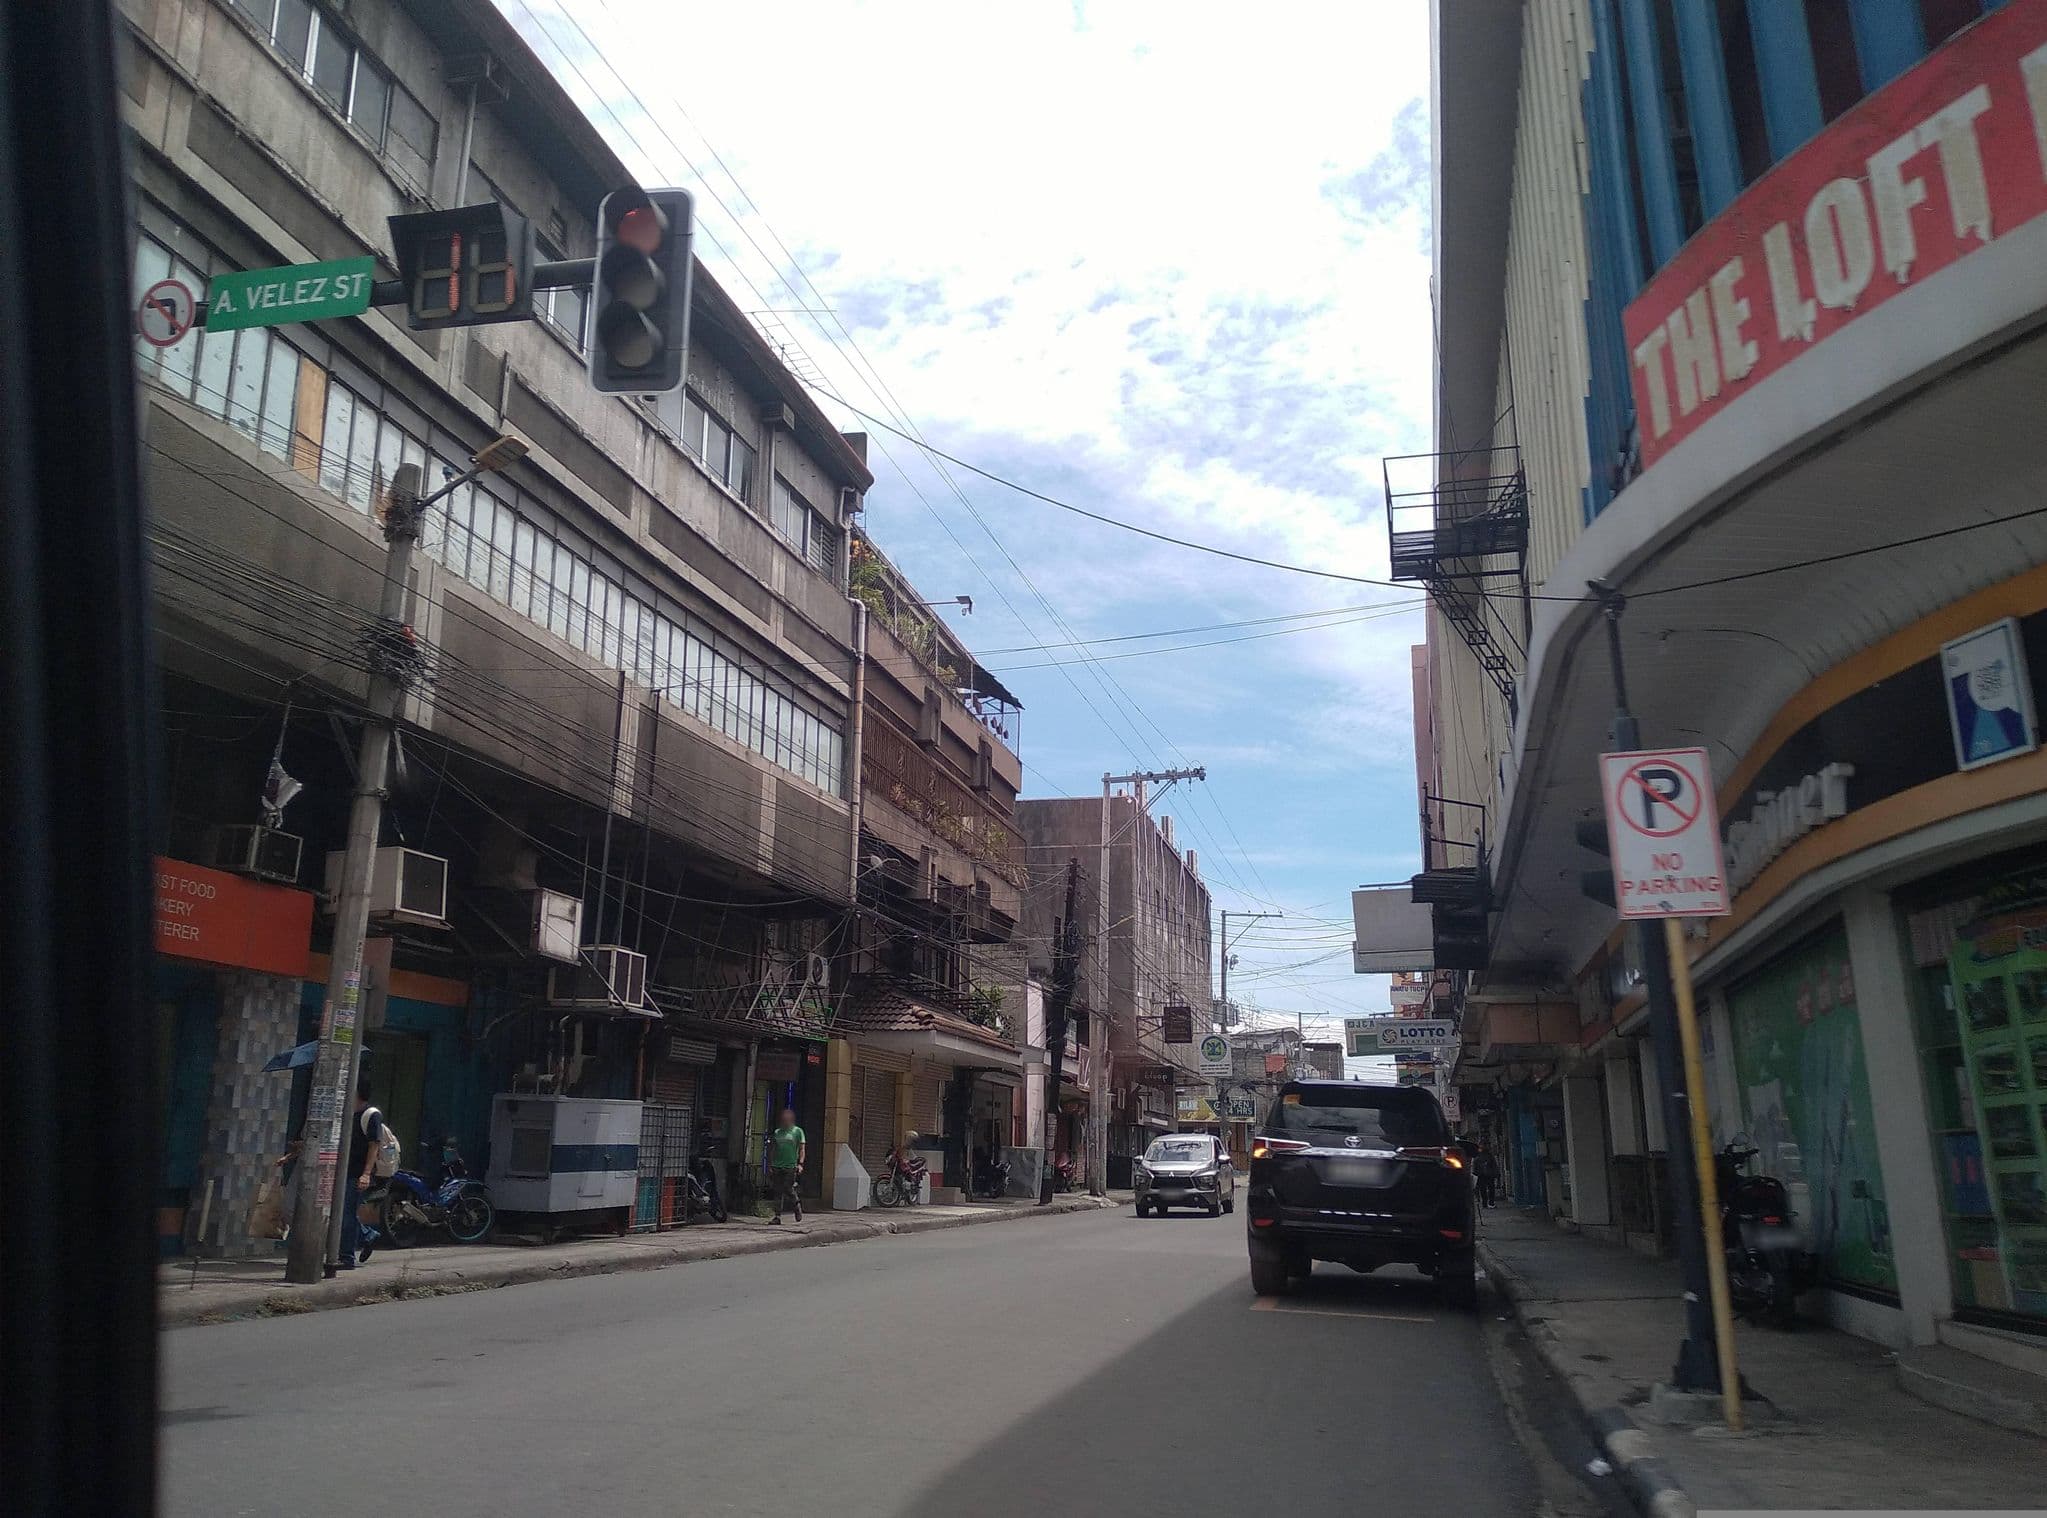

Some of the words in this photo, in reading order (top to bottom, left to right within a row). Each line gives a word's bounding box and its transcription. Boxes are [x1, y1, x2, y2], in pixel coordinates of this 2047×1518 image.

[1633, 256, 1762, 440] THE
[1763, 84, 1996, 343] LOFT
[213, 289, 237, 315] A.
[246, 277, 329, 310] VELEZ
[332, 272, 368, 300] ST
[1651, 852, 1685, 872] NO
[179, 878, 217, 899] FOOD
[1619, 875, 1722, 897] PARKING
[1400, 1027, 1446, 1038] LOTTO
